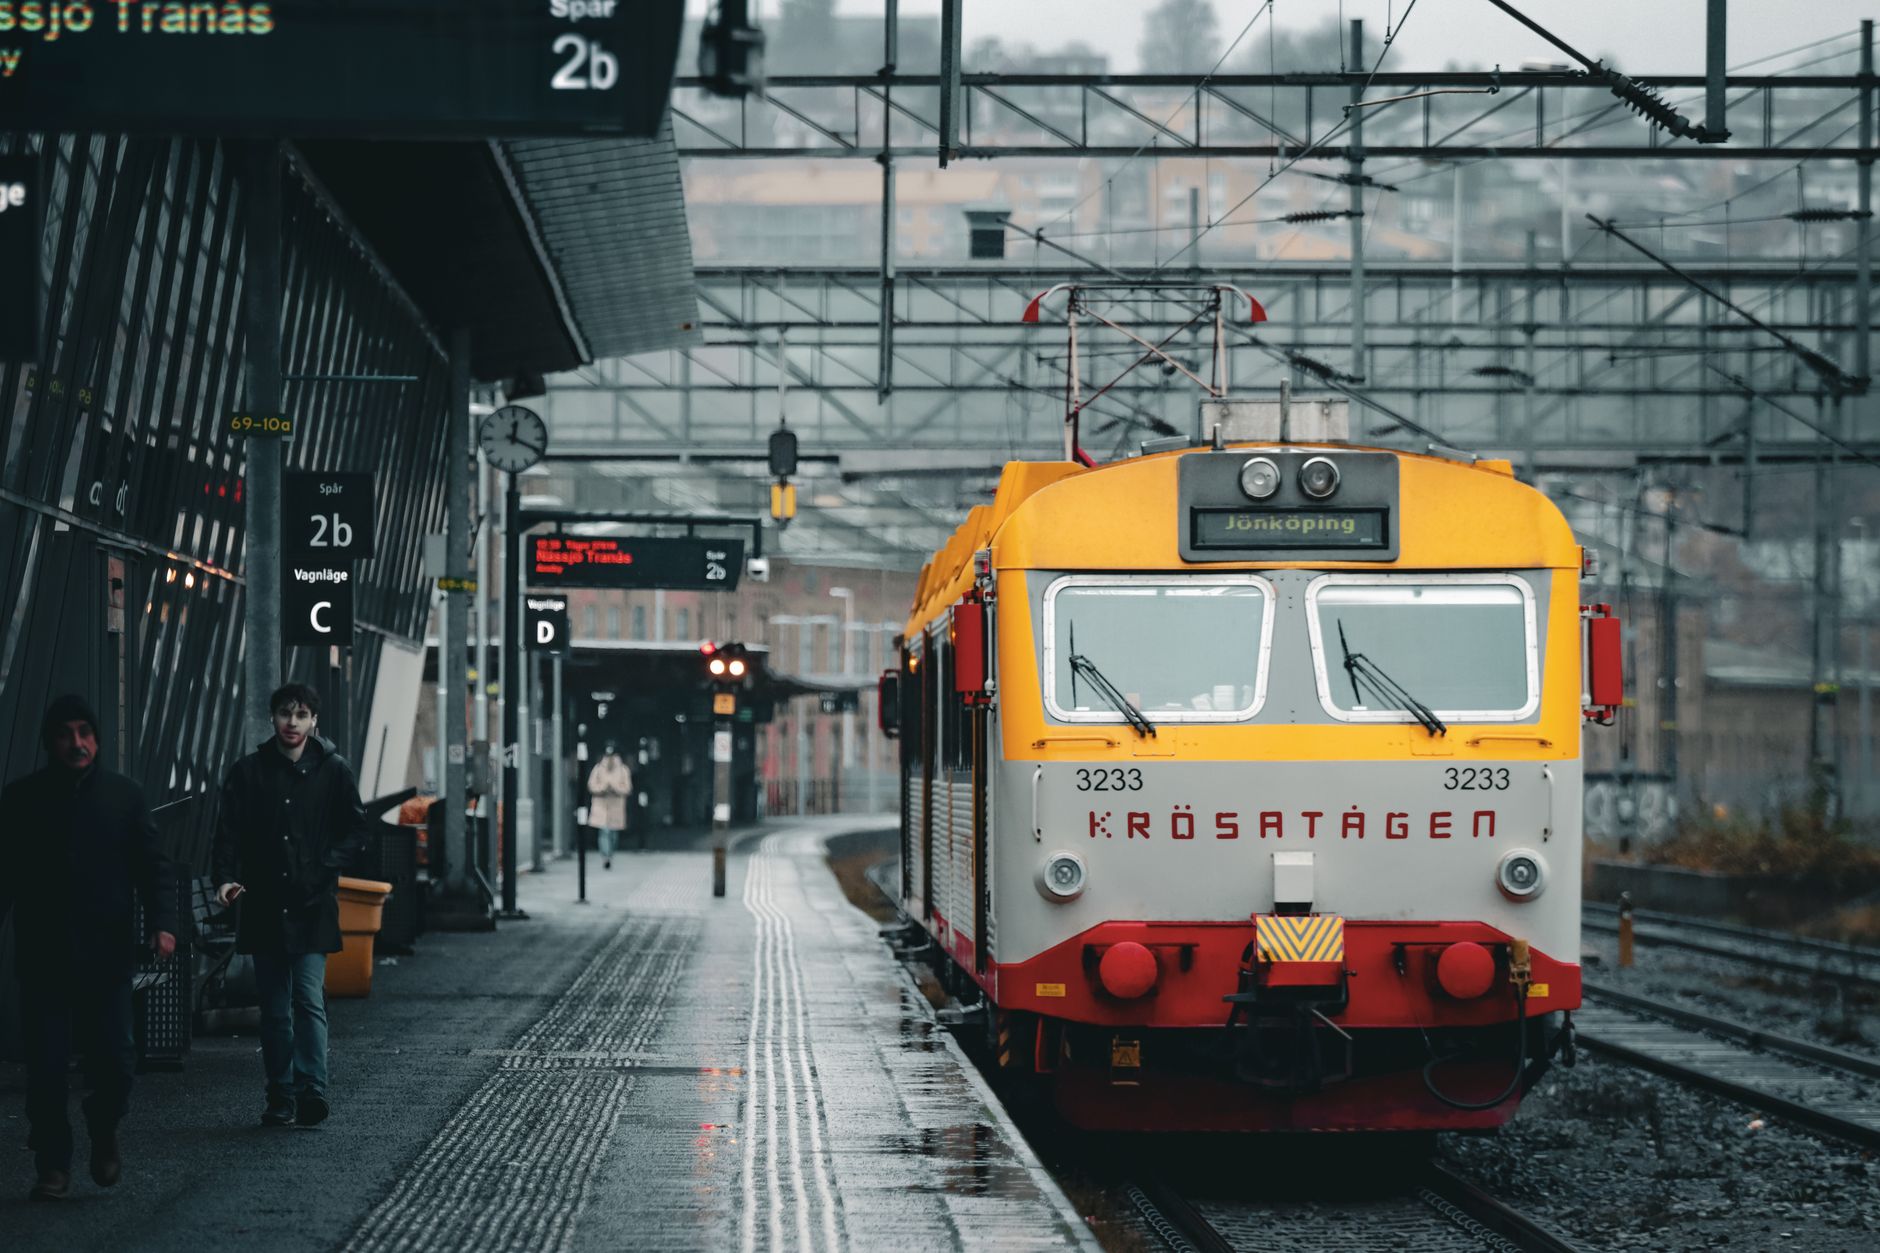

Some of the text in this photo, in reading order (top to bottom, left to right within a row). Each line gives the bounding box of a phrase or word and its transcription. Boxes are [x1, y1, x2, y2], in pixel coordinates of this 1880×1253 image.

[551, 33, 619, 90] 2b
[231, 416, 292, 432] 69-10a
[319, 482, 343, 495] Spår
[309, 512, 353, 547] 2b
[1225, 514, 1356, 534] Jönköping
[294, 568, 348, 584] Vagnläge
[705, 562, 727, 580] 2b
[310, 601, 332, 633] C
[536, 620, 556, 644] D
[1076, 768, 1144, 792] 3233
[1443, 767, 1511, 791] 3233
[1088, 804, 1497, 841] KRÖSATÅGEN
